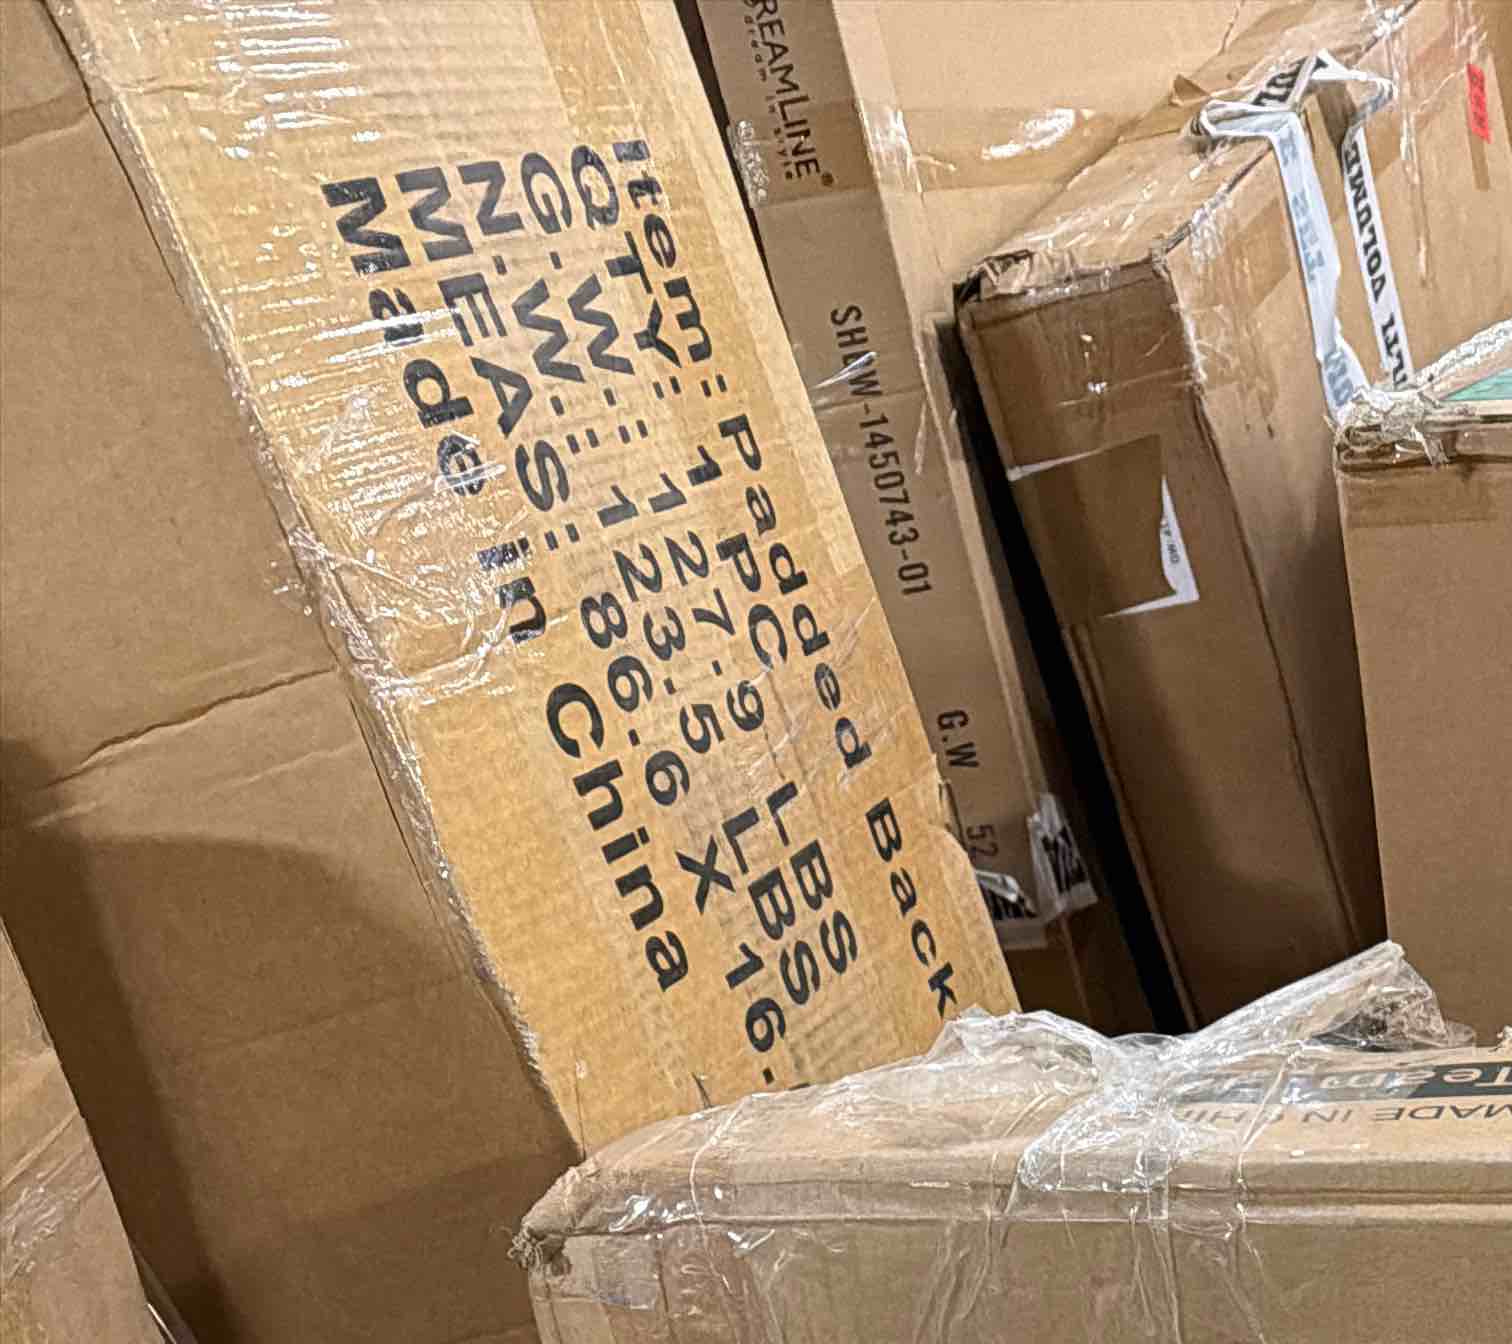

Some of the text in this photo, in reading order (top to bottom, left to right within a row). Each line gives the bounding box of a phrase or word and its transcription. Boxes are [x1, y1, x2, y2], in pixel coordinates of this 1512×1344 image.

[748, 0, 821, 179] REAMLINE
[1344, 141, 1388, 303] VOLUME
[321, 177, 689, 992] Made in China
[395, 167, 800, 1089] MEAS: 86.6 X 16.
[597, 485, 726, 754] 123.5
[721, 807, 821, 1005] LBS
[613, 140, 958, 1018] Item: Padded Back
[648, 472, 766, 731] 127.9
[766, 781, 859, 976] LBS
[686, 445, 723, 487] 1
[716, 532, 788, 673] PC
[1301, 1103, 1354, 1123] IN
